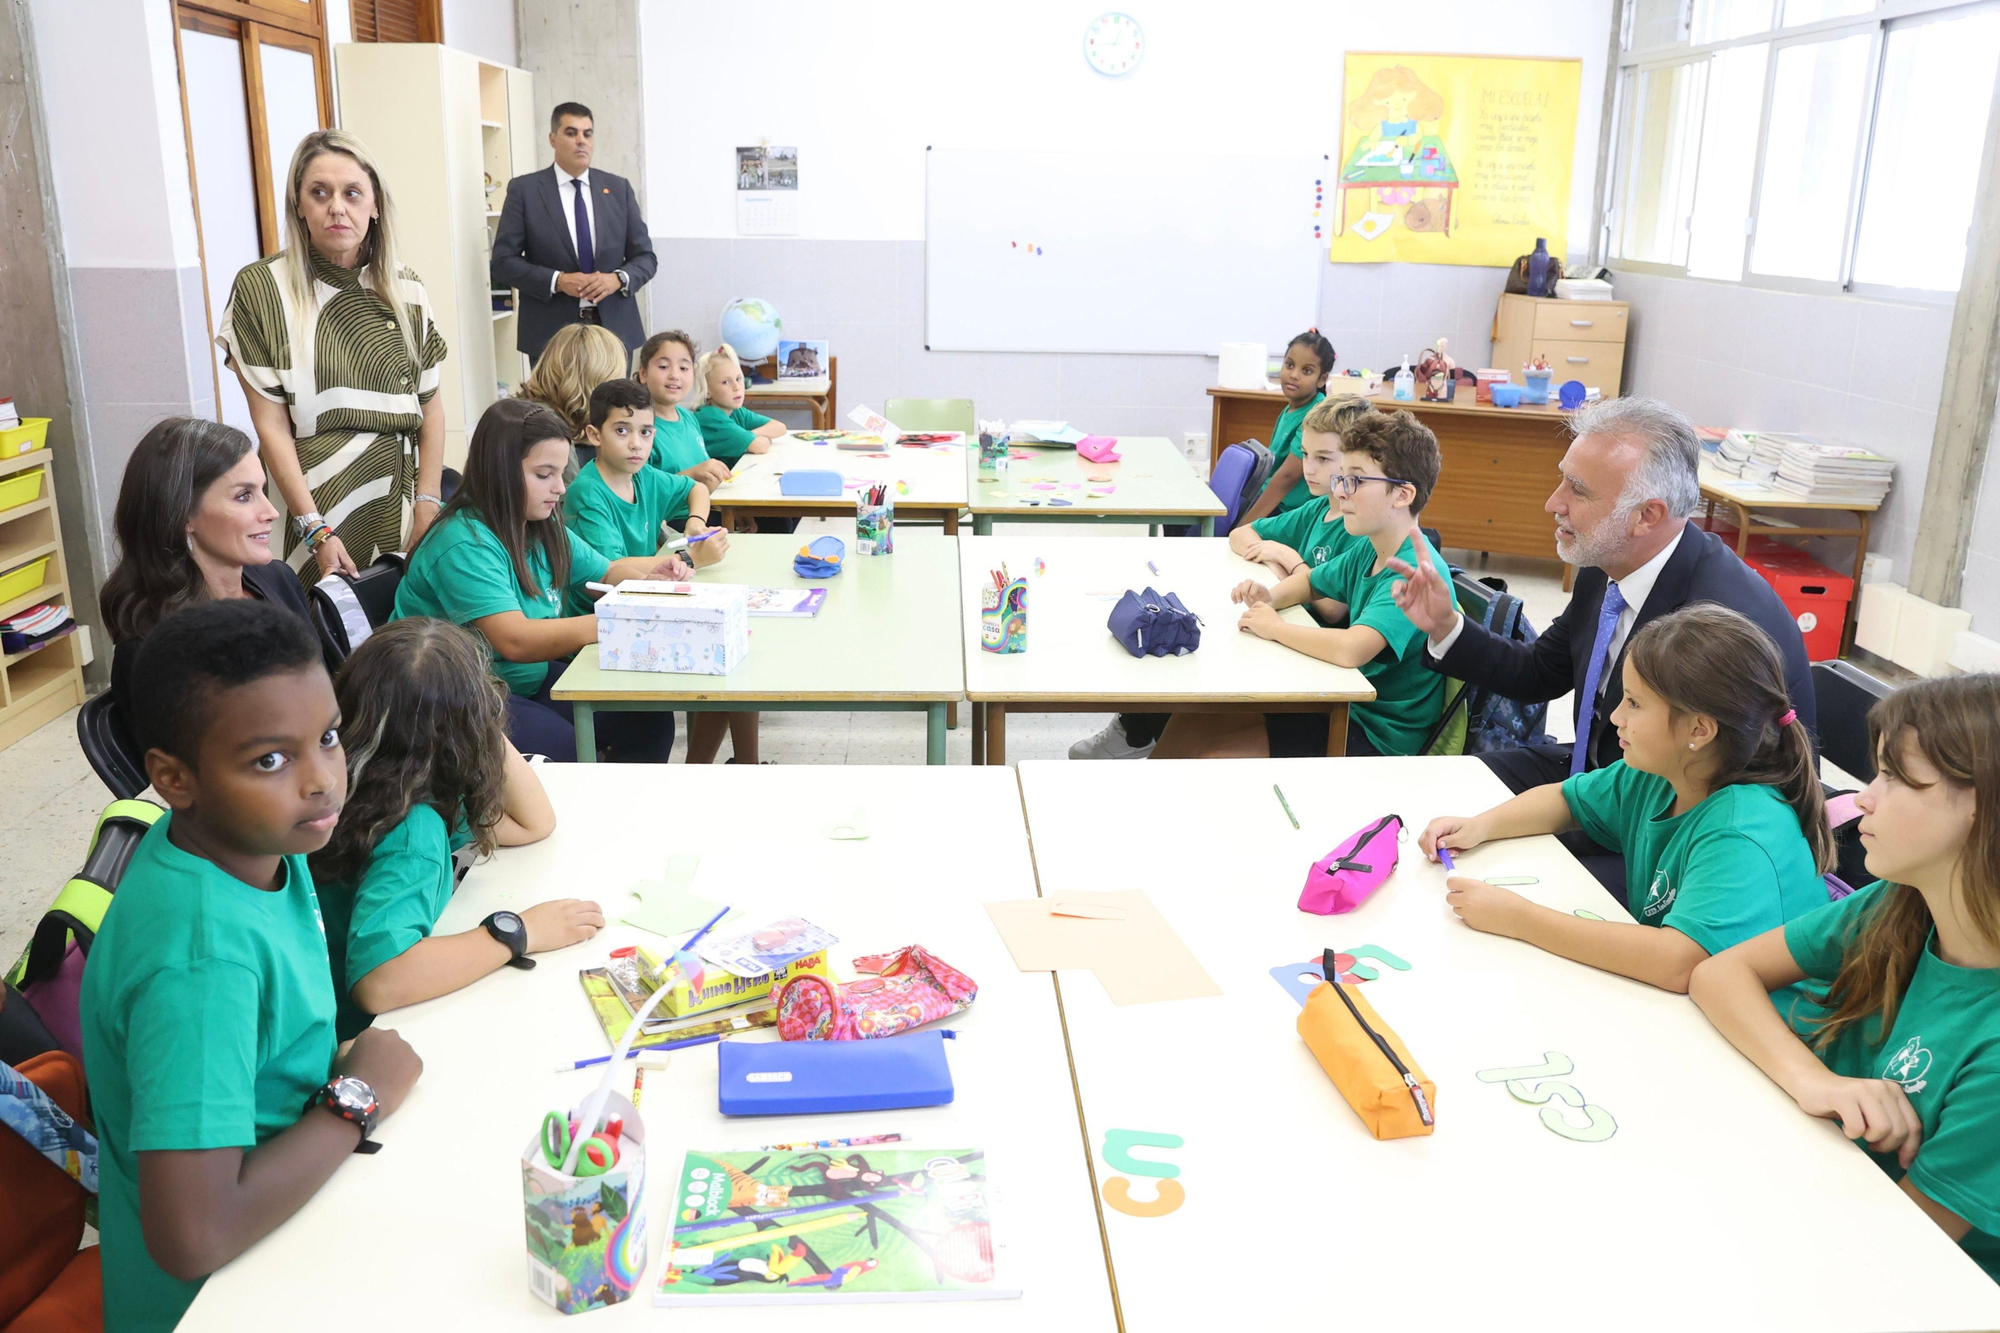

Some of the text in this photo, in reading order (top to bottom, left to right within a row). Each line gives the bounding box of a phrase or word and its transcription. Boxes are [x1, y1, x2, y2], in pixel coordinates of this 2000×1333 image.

[597, 628, 612, 636] aby
[983, 625, 1000, 634] casa
[795, 956, 821, 970] HABA
[733, 973, 770, 995] HERO
[704, 1172, 726, 1217] Malblock
